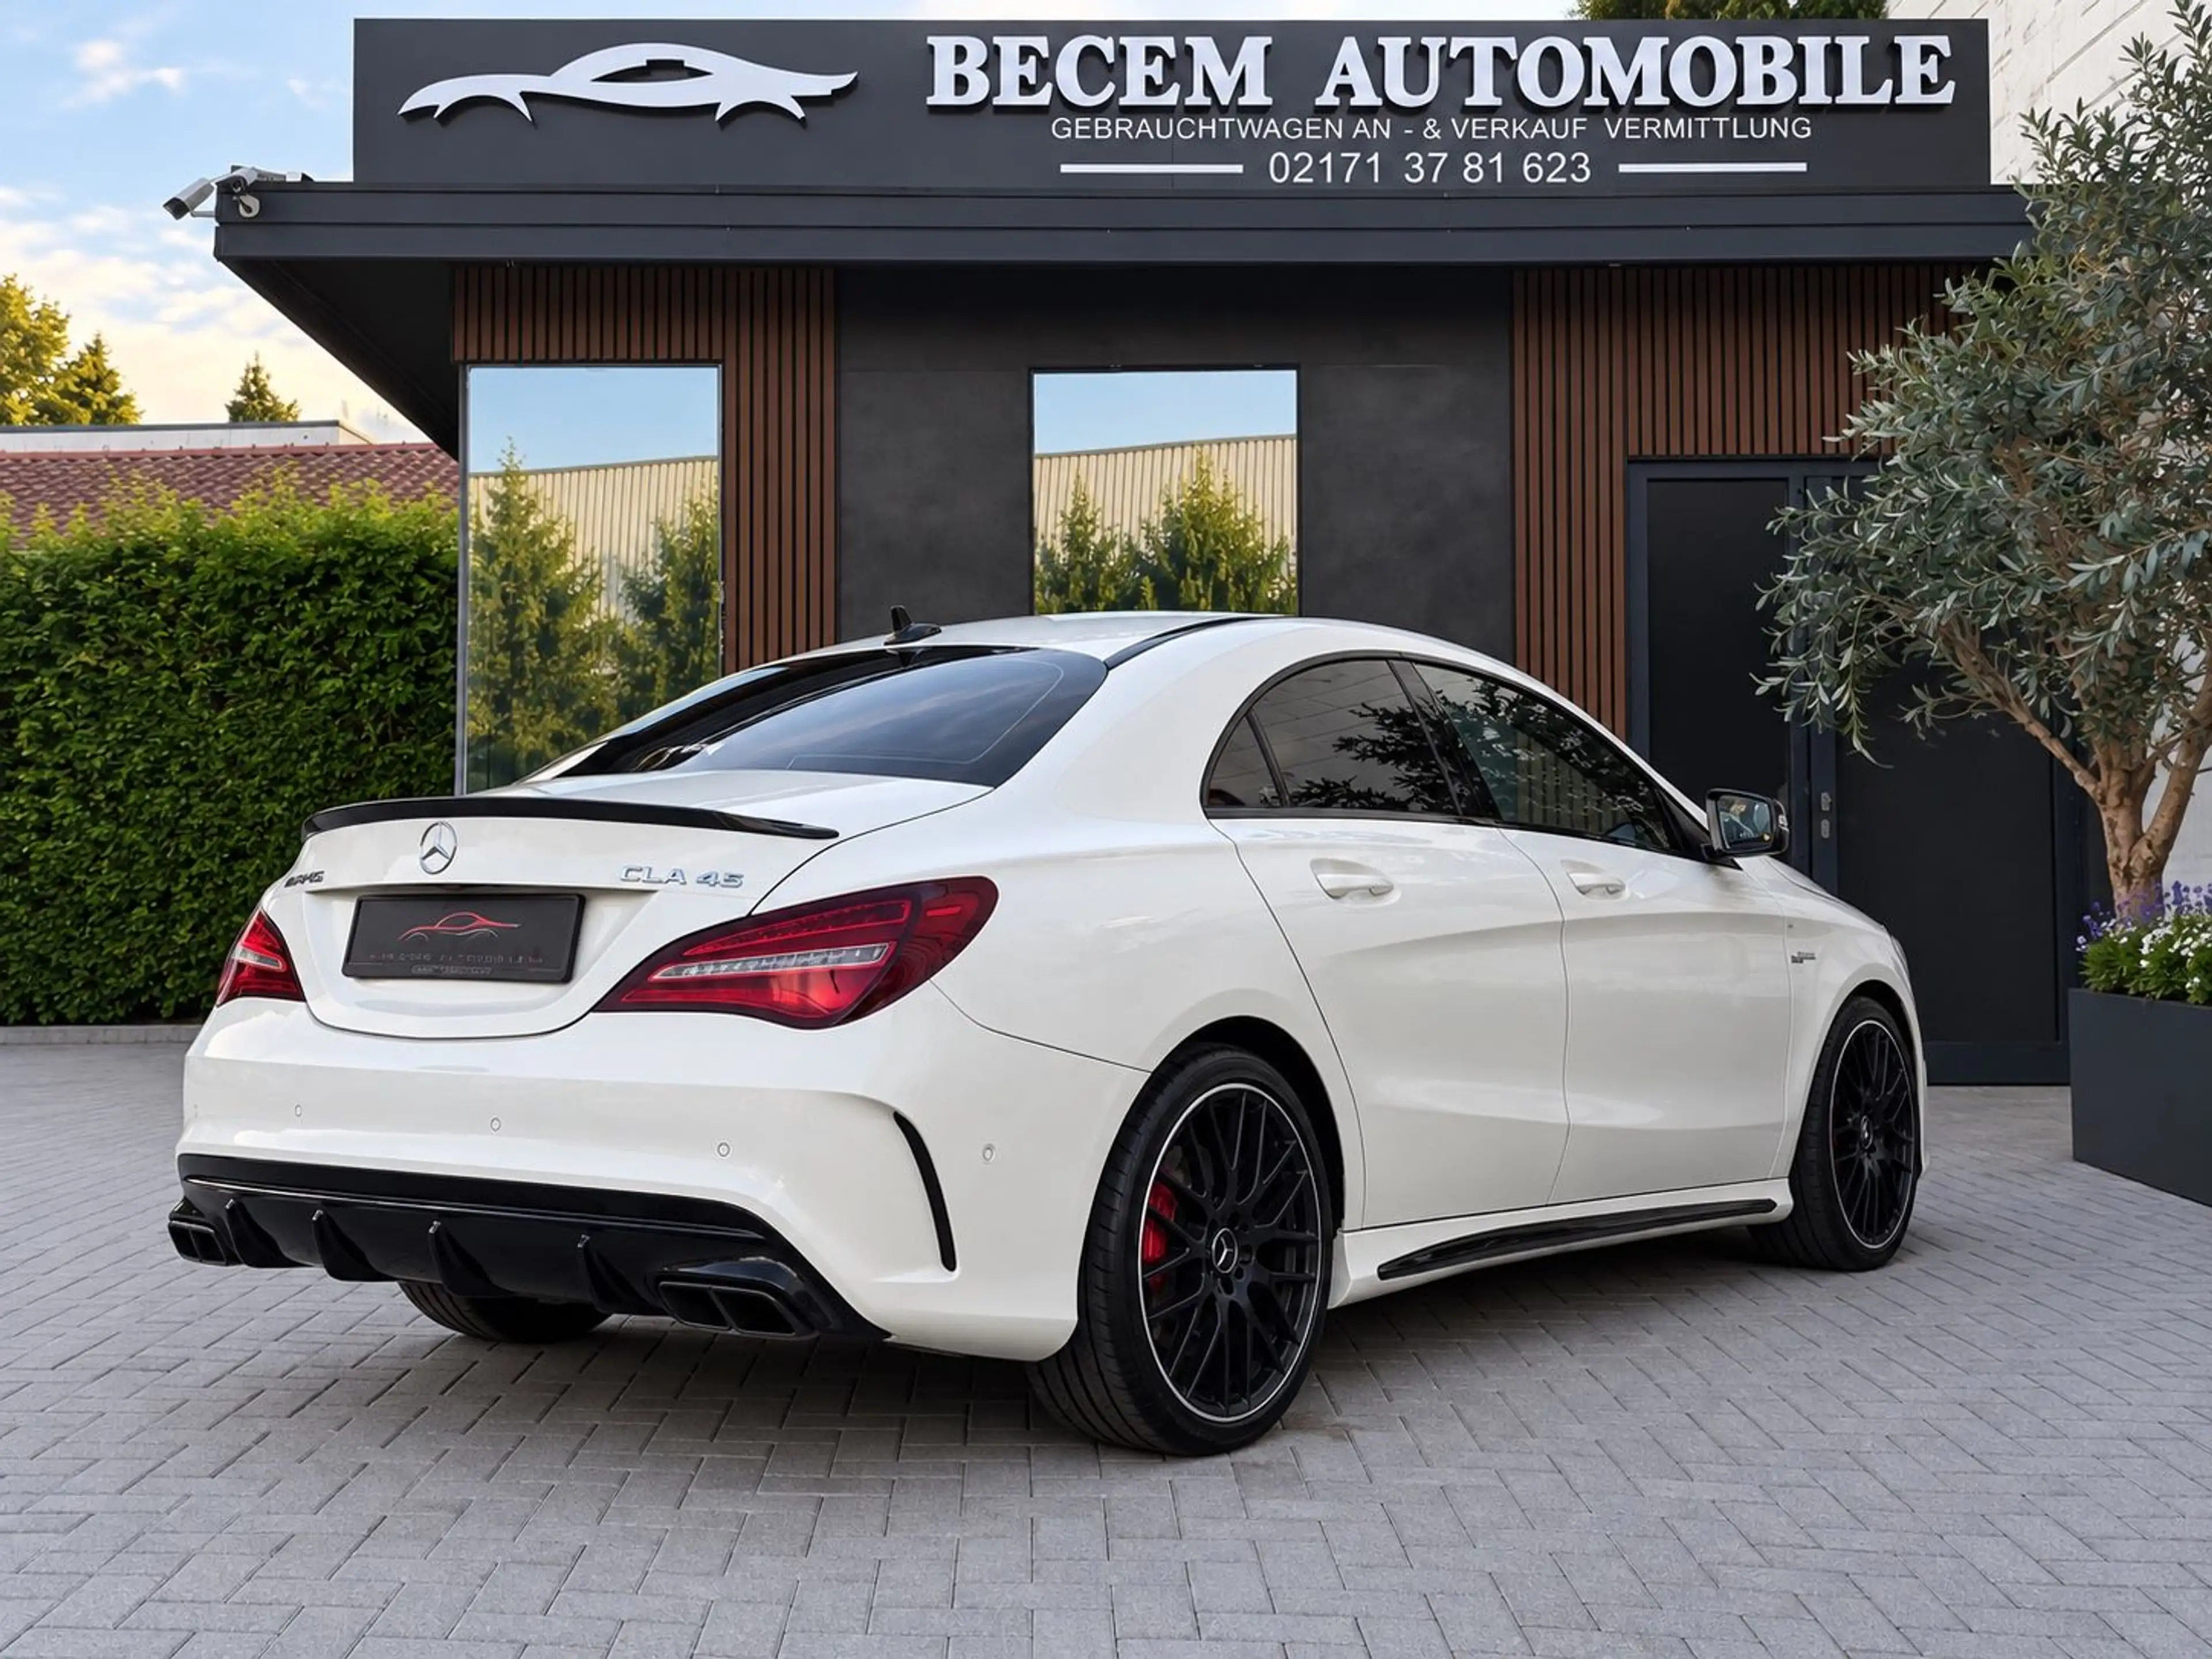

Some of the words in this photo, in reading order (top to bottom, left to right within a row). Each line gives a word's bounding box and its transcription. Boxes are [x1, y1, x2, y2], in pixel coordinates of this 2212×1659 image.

[926, 35, 1274, 107] BECEM
[1315, 35, 1956, 108] AUTOMOBILE
[1051, 117, 1343, 140] GEBRAUCHTWAGEN
[1351, 117, 1391, 140] AN
[1422, 117, 1442, 140] &
[1450, 117, 1588, 139] VERKAUF
[1603, 116, 1812, 139] VERMITTLUNG
[1268, 151, 1381, 184] 02171
[1403, 151, 1449, 184] 37
[1463, 151, 1505, 184] 81
[1522, 151, 1592, 184] 623
[620, 866, 687, 885] CLA
[696, 870, 744, 888] 45
